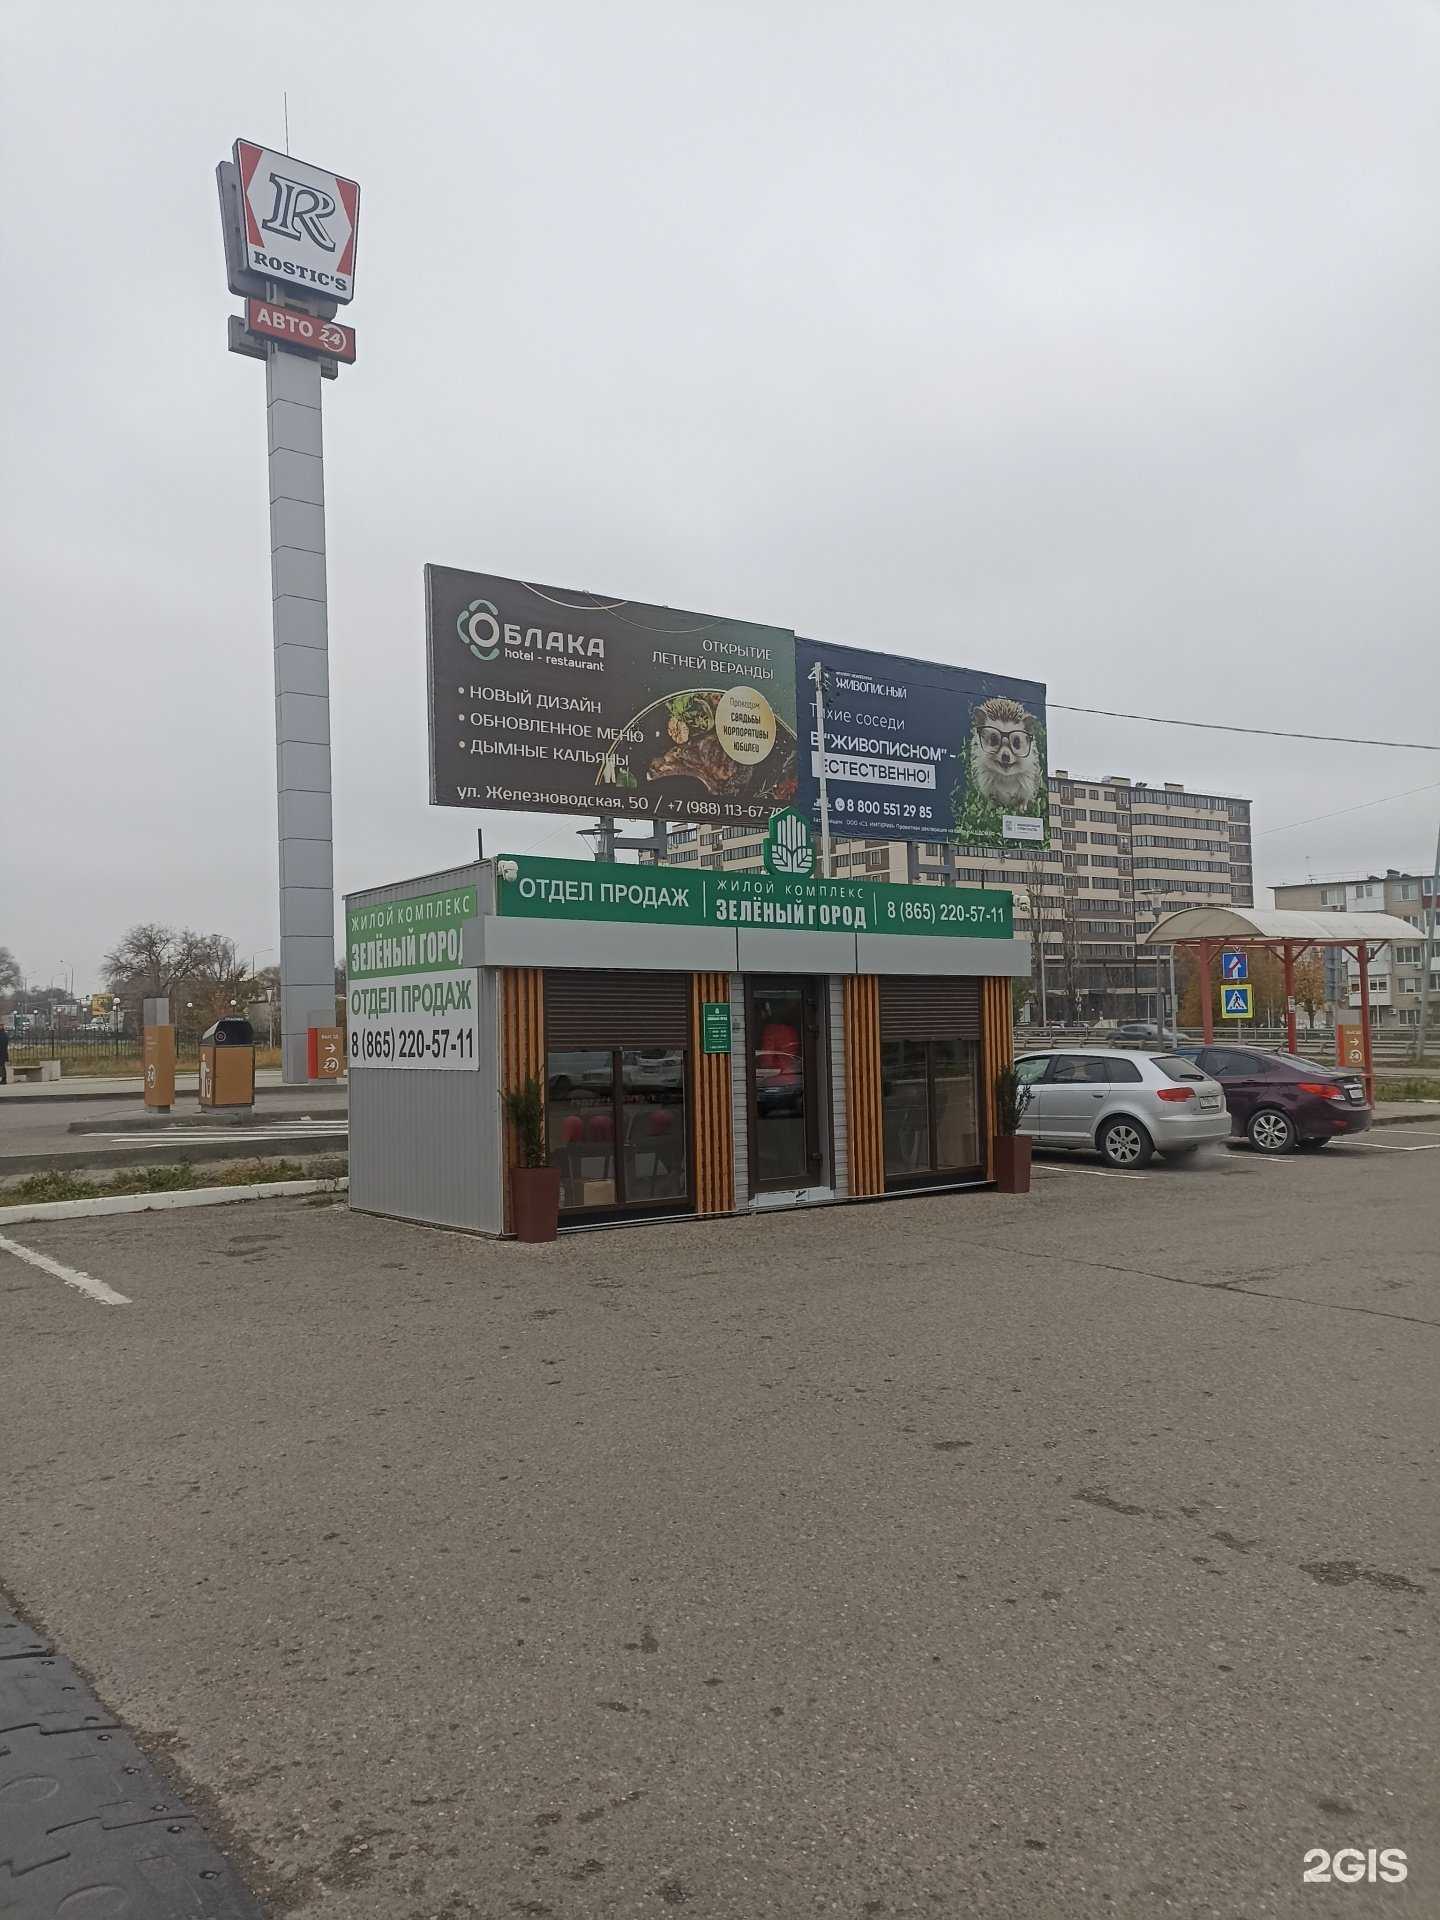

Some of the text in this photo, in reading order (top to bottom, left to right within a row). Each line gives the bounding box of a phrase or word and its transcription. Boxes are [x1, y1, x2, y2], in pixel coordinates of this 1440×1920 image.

[262, 172, 336, 253] R
[254, 251, 347, 291] ROSTIC'S
[257, 308, 341, 348] АВТО 24
[468, 612, 605, 658] ОБЛАКА
[702, 639, 771, 660] ОТКРЫТИЕ
[504, 648, 534, 662] hotel
[546, 655, 604, 672] restaurant
[652, 651, 773, 680] ЛЕТНЕЙ ВЕРАНДЫ
[470, 685, 601, 713] НОВЫЙ ДИЗАЙН
[836, 677, 907, 699] ЖИВОПИСНЫЙ
[470, 712, 644, 743] ОБНОВЛЕННОЕ МЕНЮ
[809, 703, 905, 731] Тхие соседи
[723, 726, 769, 740] КОРПОРАТИВЫ
[470, 739, 629, 766] ДЫМНЫЕ КАЛЬЯНЫ
[457, 786, 480, 800] ул.
[629, 797, 649, 810] 50
[654, 794, 663, 814] /
[667, 800, 683, 812] +7
[686, 801, 720, 816] (988)
[847, 799, 932, 819] 8 800 551 29 85
[519, 877, 688, 909] ОТДЕЛ ПРОДАЖ
[717, 879, 864, 899] ЖИЛОЙ КОМПЛЕКС
[352, 896, 469, 932] ЖИЛОЙ КОМПЛЕКС
[716, 895, 867, 928] ЗЕЛЁНЫЙ ГОРОД
[887, 901, 1004, 925] 8 (865) 220-57-11
[352, 928, 416, 972] ЗЕЛЁНЫЙ
[351, 980, 472, 1019] ОТДЕЛ ПРОДАЖ
[351, 1027, 473, 1061] 8 (865) 220-57-11
